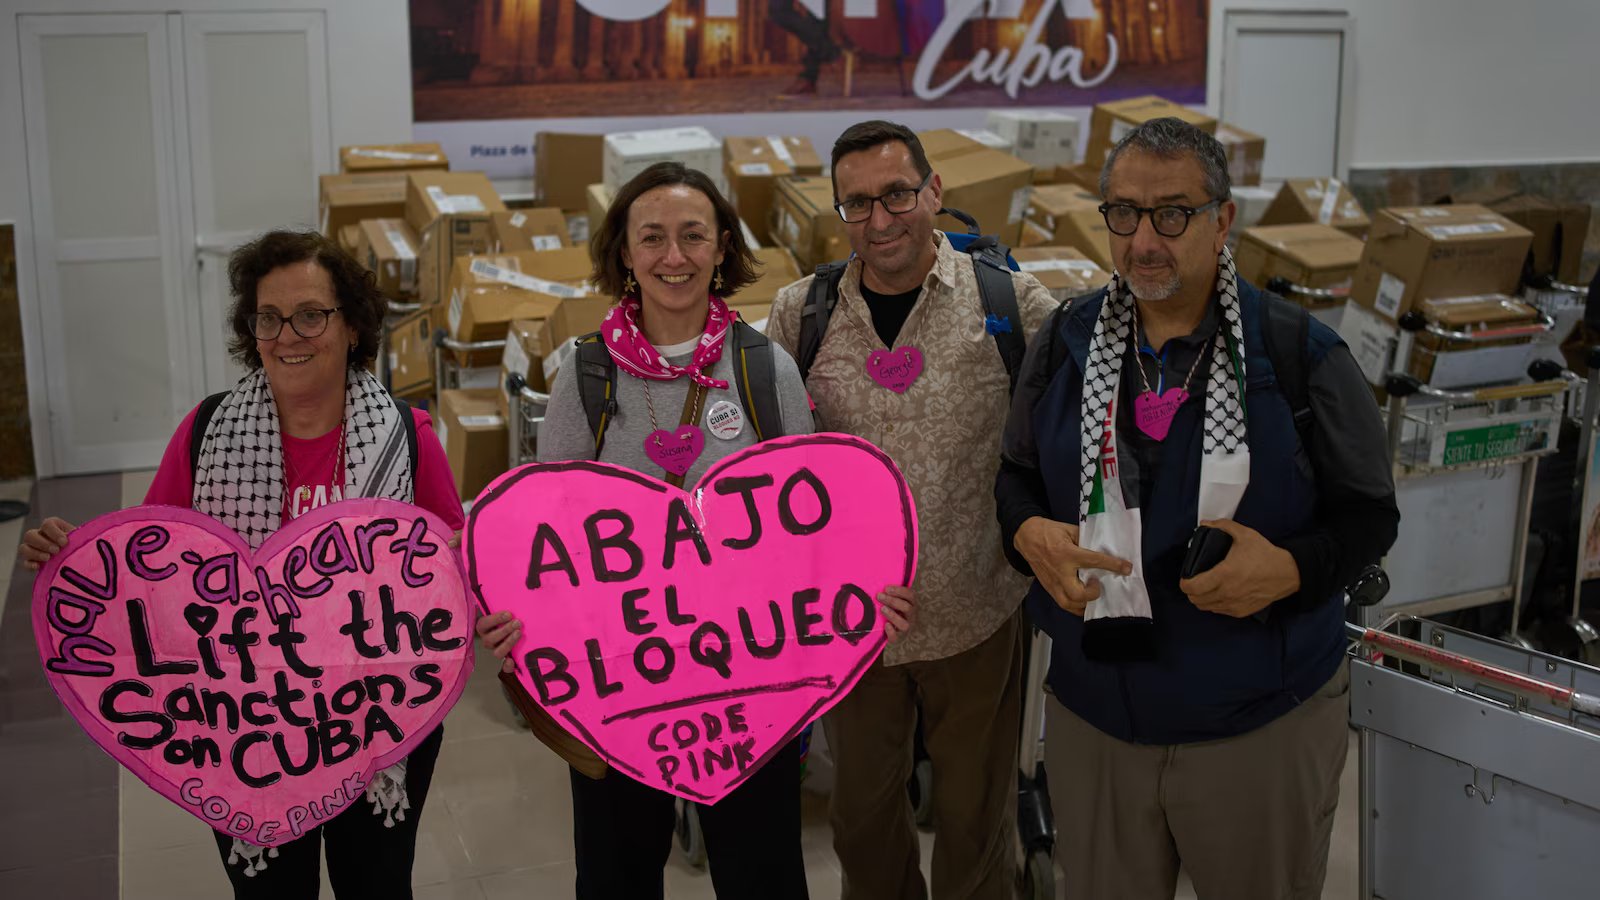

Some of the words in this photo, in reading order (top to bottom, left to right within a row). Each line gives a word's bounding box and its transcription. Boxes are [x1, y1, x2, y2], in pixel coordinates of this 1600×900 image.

[911, 0, 1120, 100] Cuba
[710, 412, 729, 425] CUBA
[526, 467, 832, 589] ABAJO
[47, 526, 178, 676] have
[257, 517, 437, 625] heart
[127, 597, 324, 683] Lift
[339, 585, 466, 658] the
[622, 585, 696, 635] EL
[524, 583, 876, 707] BLOQUEO
[100, 664, 443, 750] Sanctions
[163, 737, 221, 768] on
[230, 705, 404, 788] CUBA
[648, 703, 750, 753] CODE
[656, 737, 755, 789] PINK
[180, 778, 281, 843] CODE
[287, 772, 366, 836] PINK
